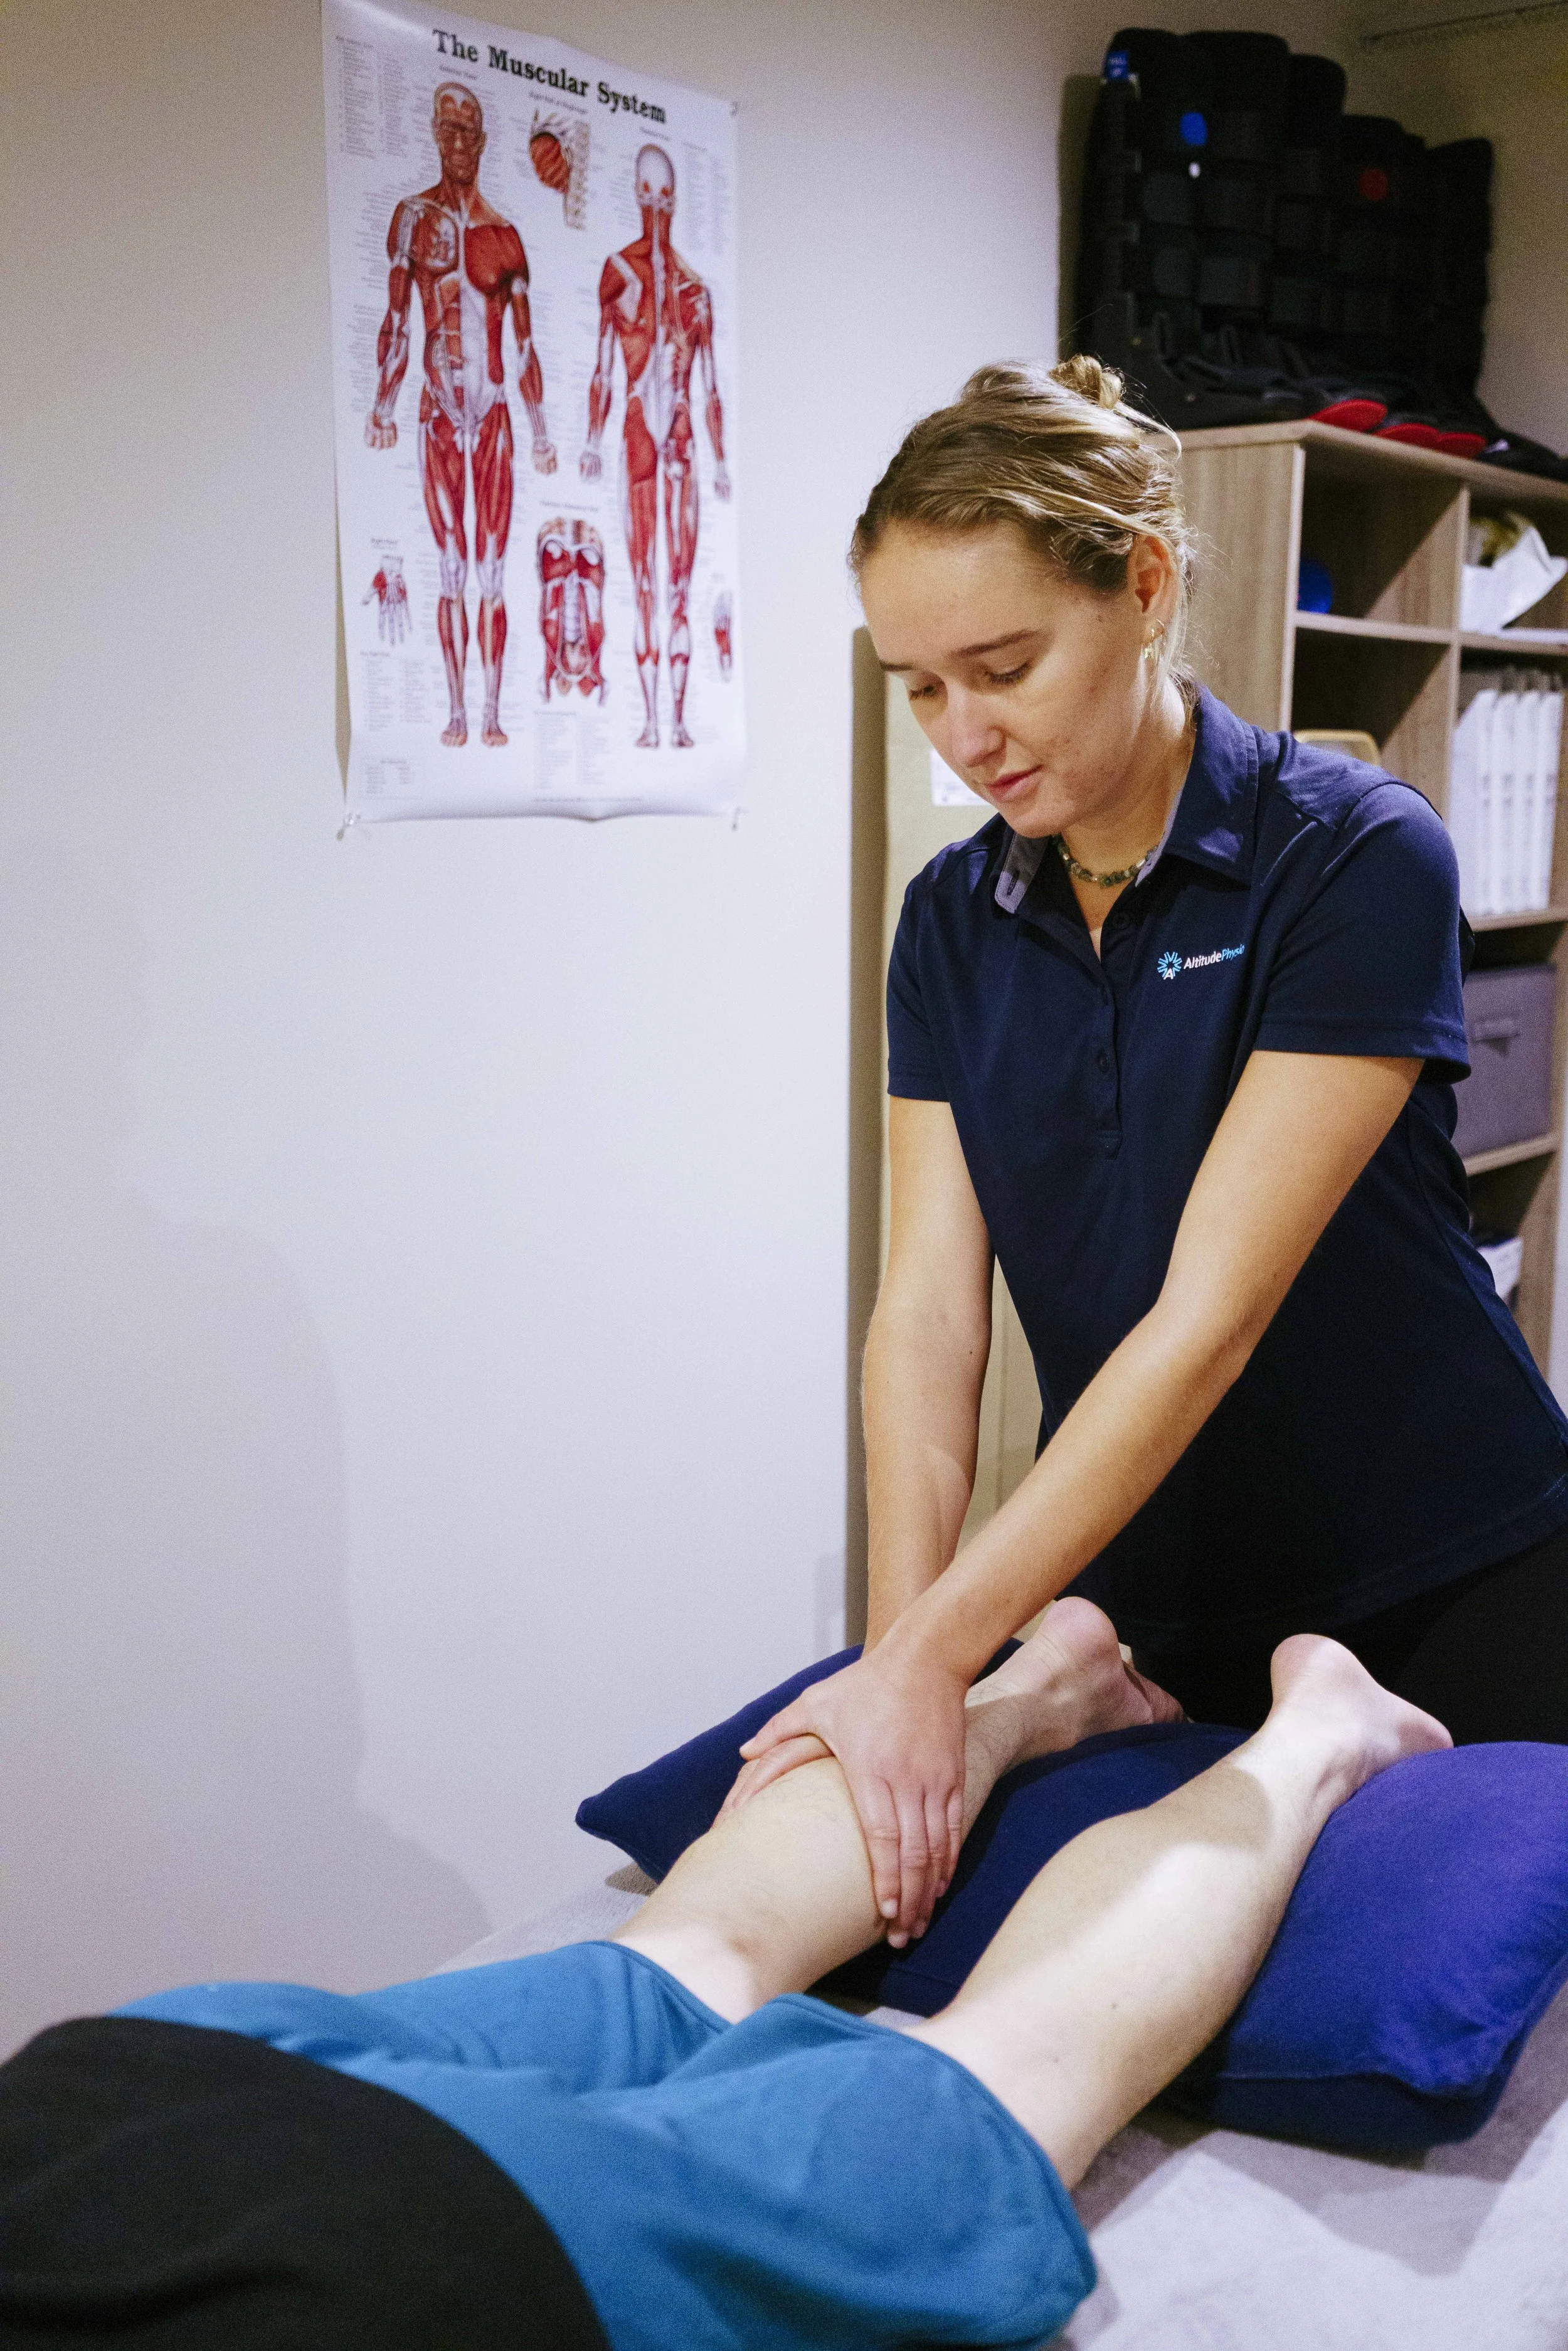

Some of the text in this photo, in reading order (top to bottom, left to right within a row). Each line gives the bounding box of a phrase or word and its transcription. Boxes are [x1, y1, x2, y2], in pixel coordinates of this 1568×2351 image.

[433, 28, 479, 61] The
[488, 45, 588, 97] Muscular
[597, 82, 666, 124] System
